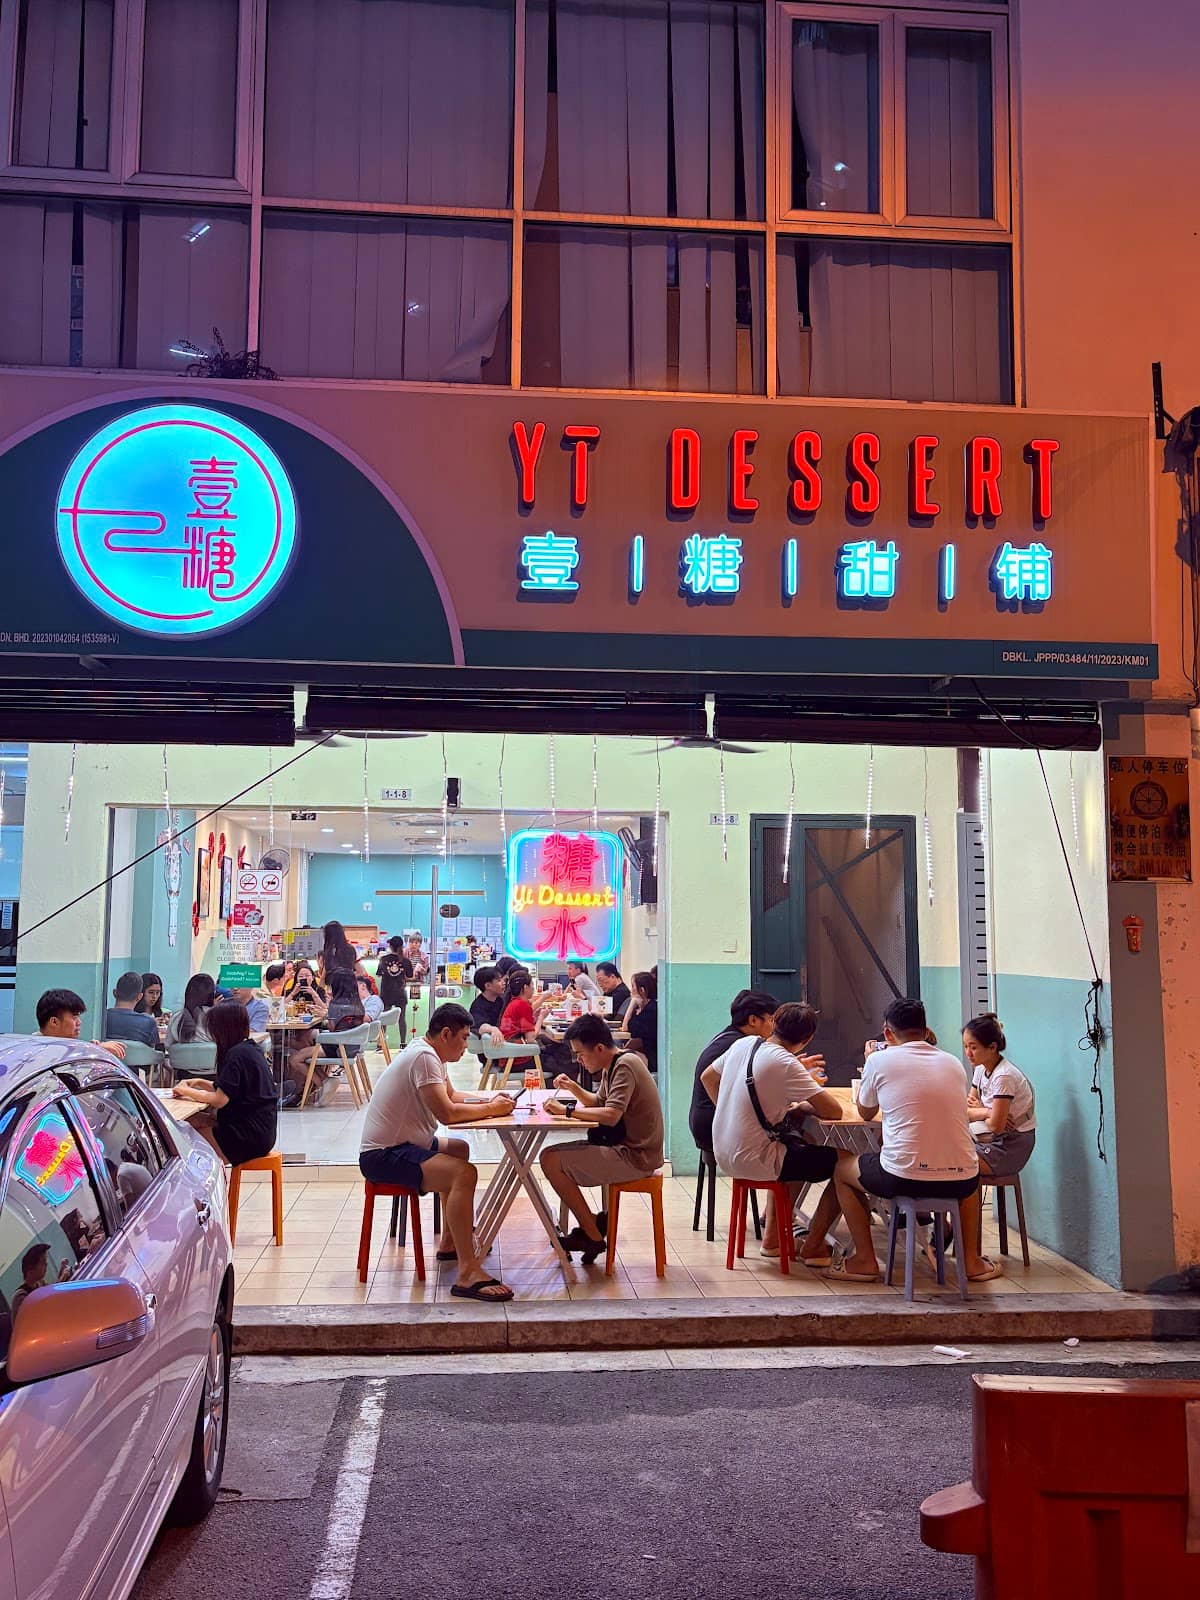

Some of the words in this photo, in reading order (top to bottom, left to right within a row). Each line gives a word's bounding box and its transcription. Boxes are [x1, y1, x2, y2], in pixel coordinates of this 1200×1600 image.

[513, 421, 600, 506] YT
[671, 428, 1060, 519] DESSERT
[183, 456, 237, 593] 壹糖
[1002, 651, 1031, 662] DBKL.
[1034, 652, 1150, 666] JPPP/03484/11/2023/KM01
[538, 885, 615, 907] Dessert
[536, 907, 596, 959] 水
